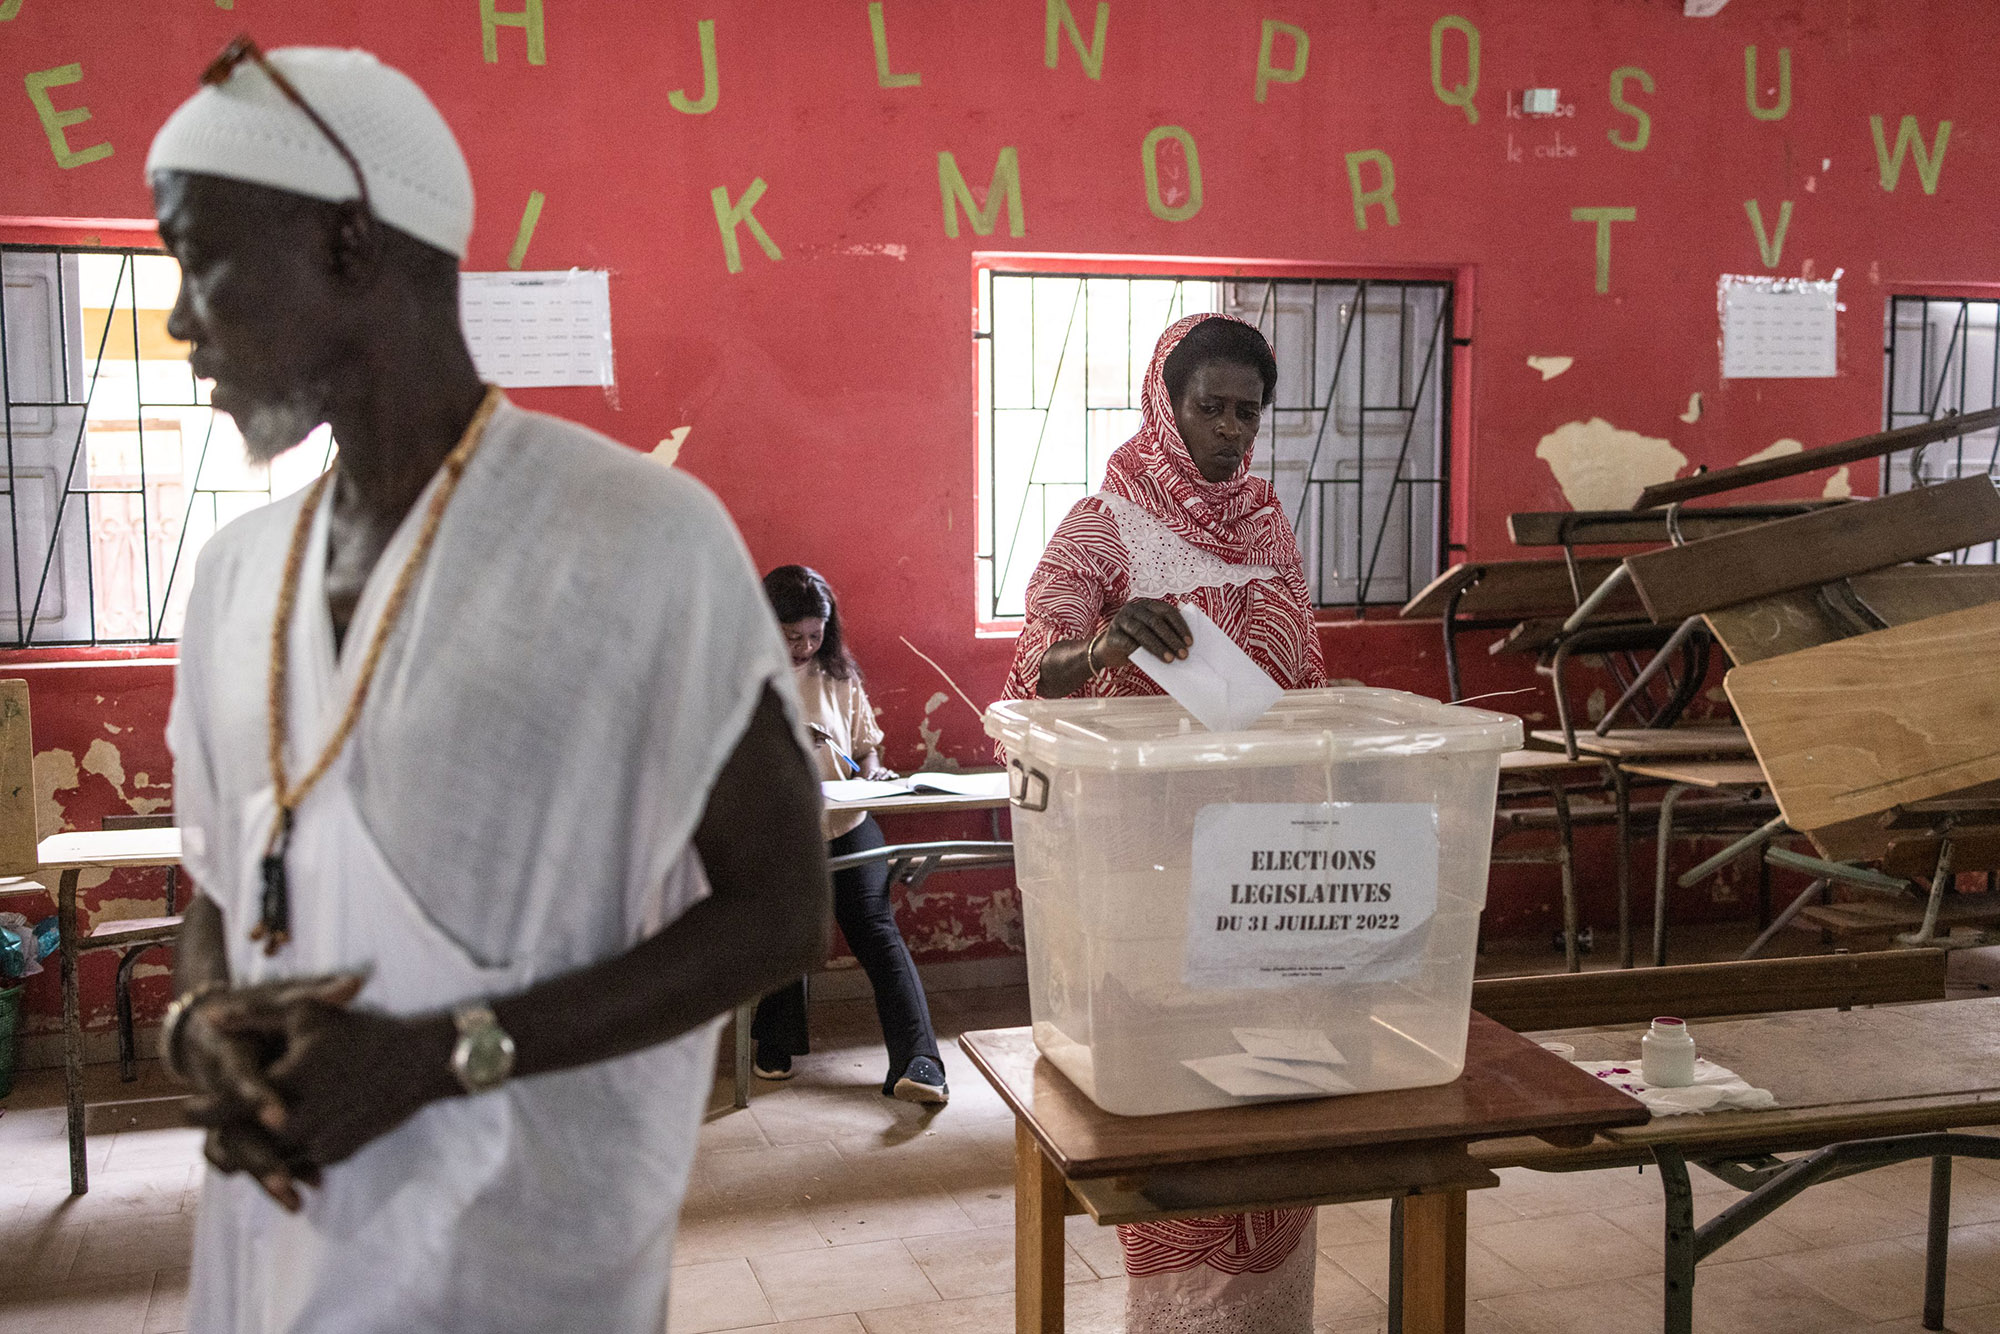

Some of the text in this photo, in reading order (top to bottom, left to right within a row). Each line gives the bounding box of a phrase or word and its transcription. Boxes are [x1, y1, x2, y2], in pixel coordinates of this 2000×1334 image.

[479, 0, 546, 65] H
[668, 19, 719, 114] J
[869, 2, 922, 87] L
[1045, 0, 1109, 80] N
[1256, 20, 1310, 102] P
[1430, 15, 1480, 124] Q
[24, 63, 114, 169] E
[1608, 67, 1655, 151] S
[1745, 46, 1791, 120] U
[1142, 125, 1203, 221] O
[1535, 132, 1576, 158] cube
[1870, 115, 1951, 195] W
[711, 177, 783, 273] K
[938, 146, 1025, 238] M
[1345, 149, 1399, 230] R
[1572, 207, 1636, 293] T
[1744, 200, 1793, 267] V
[1230, 883, 1392, 904] LEGISLATIVES
[1250, 850, 1377, 871] ELECTIONS
[1216, 913, 1400, 932] DU 31 JUILLET 2022
